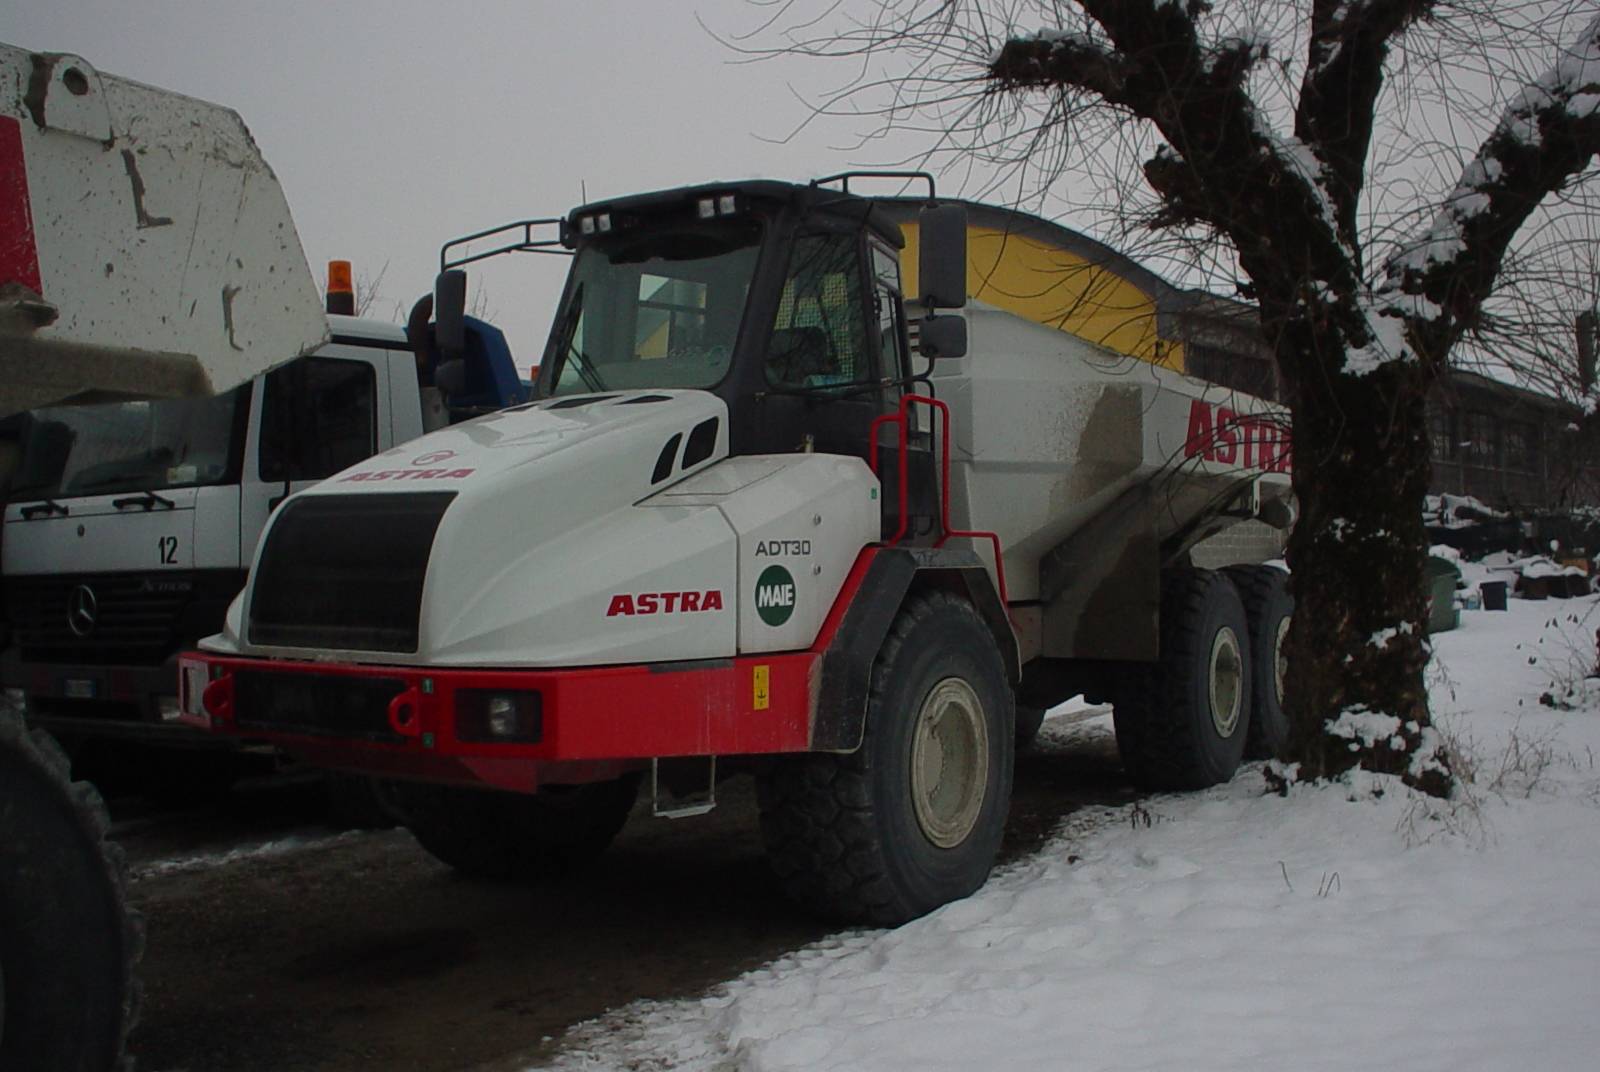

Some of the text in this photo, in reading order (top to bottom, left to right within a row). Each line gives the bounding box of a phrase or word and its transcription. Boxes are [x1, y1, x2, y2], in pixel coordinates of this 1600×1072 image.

[336, 469, 475, 482] ASTRA
[159, 536, 177, 564] 12
[755, 540, 810, 556] ADT30
[607, 591, 722, 616] ASTRA
